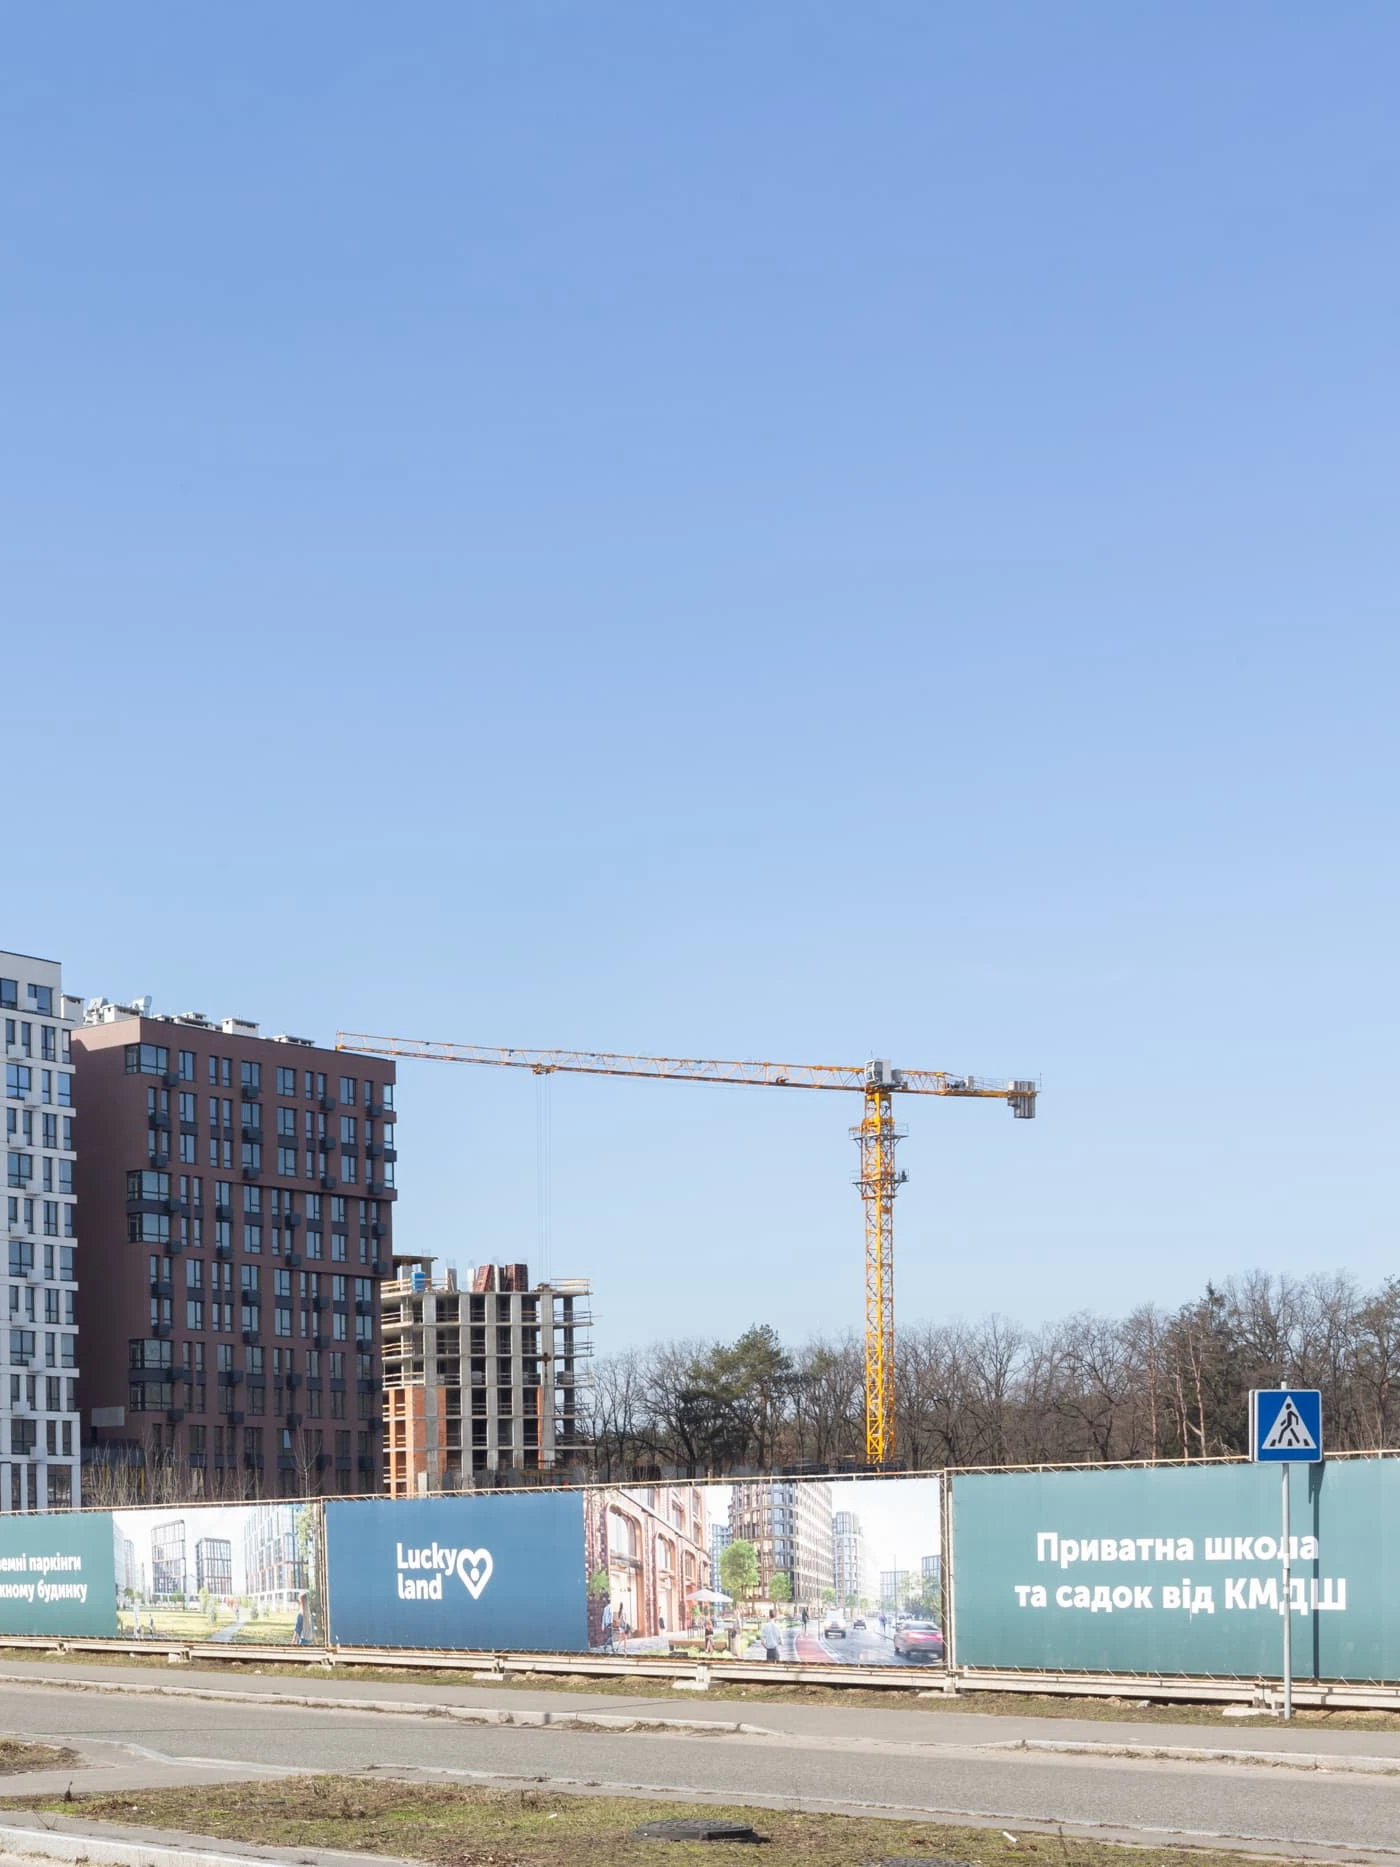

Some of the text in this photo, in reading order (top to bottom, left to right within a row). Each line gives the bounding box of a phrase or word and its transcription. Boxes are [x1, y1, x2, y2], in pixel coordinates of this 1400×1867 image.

[29, 1551, 82, 1576] паркінги
[396, 1542, 457, 1576] Lucky
[1037, 1532, 1319, 1568] Приватна школа
[37, 1579, 88, 1603] будинку
[397, 1573, 442, 1600] land
[1014, 1577, 1347, 1616] та садок від КМДШ
